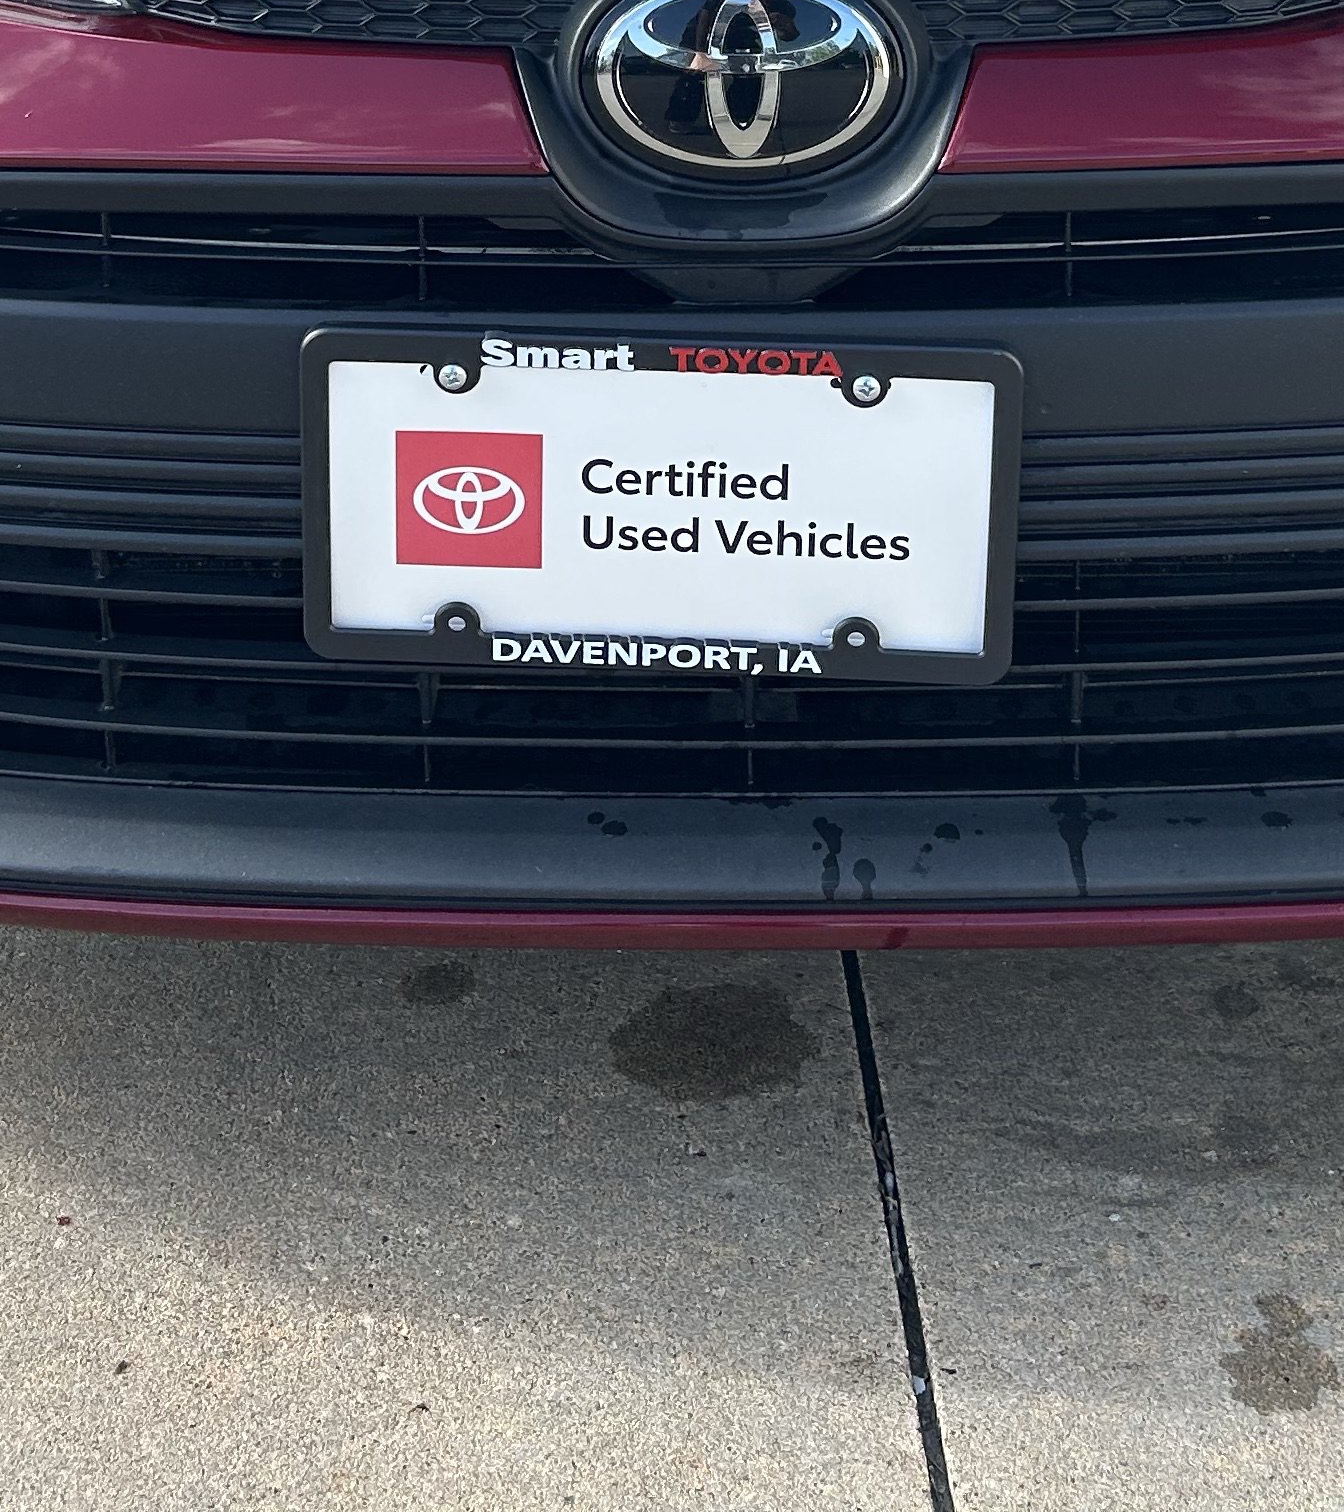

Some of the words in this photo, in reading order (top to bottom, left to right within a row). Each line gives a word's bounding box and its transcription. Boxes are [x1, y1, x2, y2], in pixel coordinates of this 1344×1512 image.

[481, 337, 635, 371] Smart
[668, 346, 844, 377] TOYOTA
[582, 458, 789, 501] Certified
[582, 515, 700, 553] Used
[714, 519, 910, 561] Vehicles
[492, 638, 764, 675] DAVENPORT,
[778, 649, 823, 674] IA
